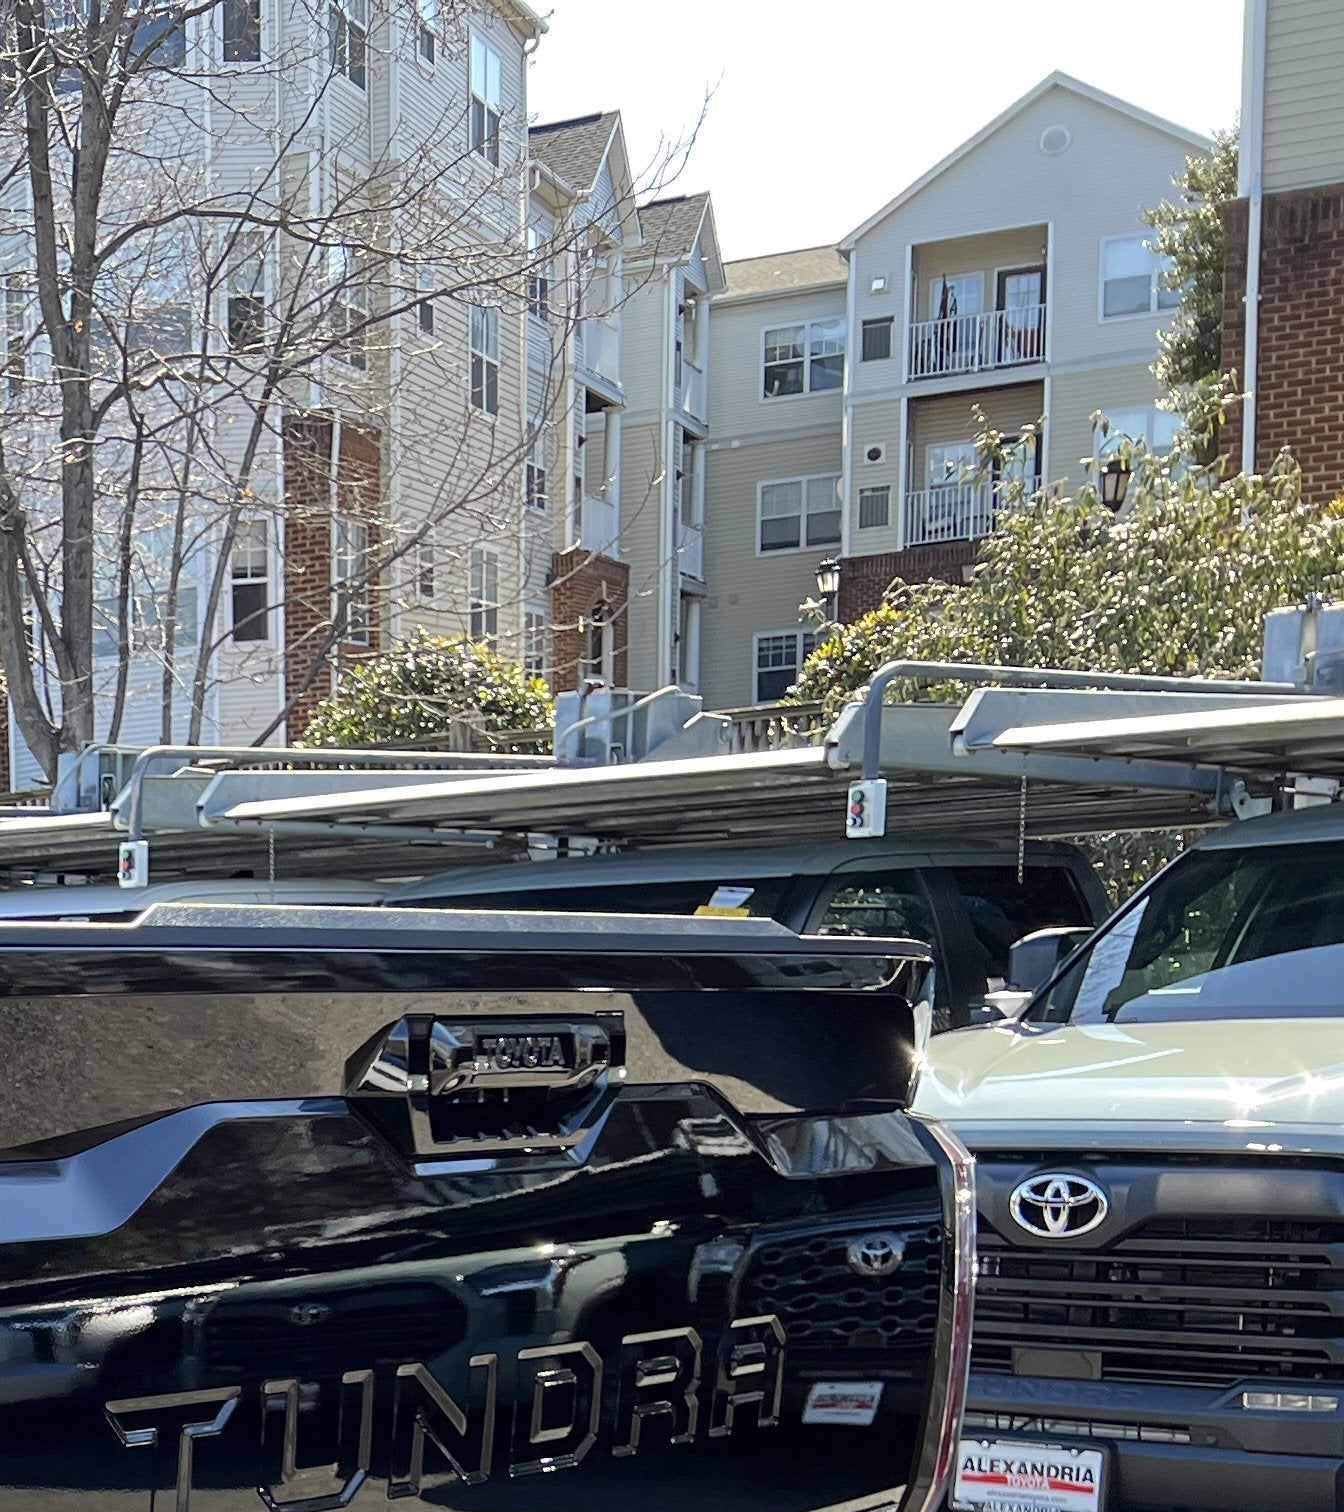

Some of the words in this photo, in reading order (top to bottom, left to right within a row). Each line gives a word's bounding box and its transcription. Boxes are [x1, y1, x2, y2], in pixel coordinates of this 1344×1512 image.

[474, 1036, 566, 1069] TOYOTA
[962, 1456, 1095, 1484] ALEXANDRIA
[1006, 1475, 1051, 1490] TOYOTA
